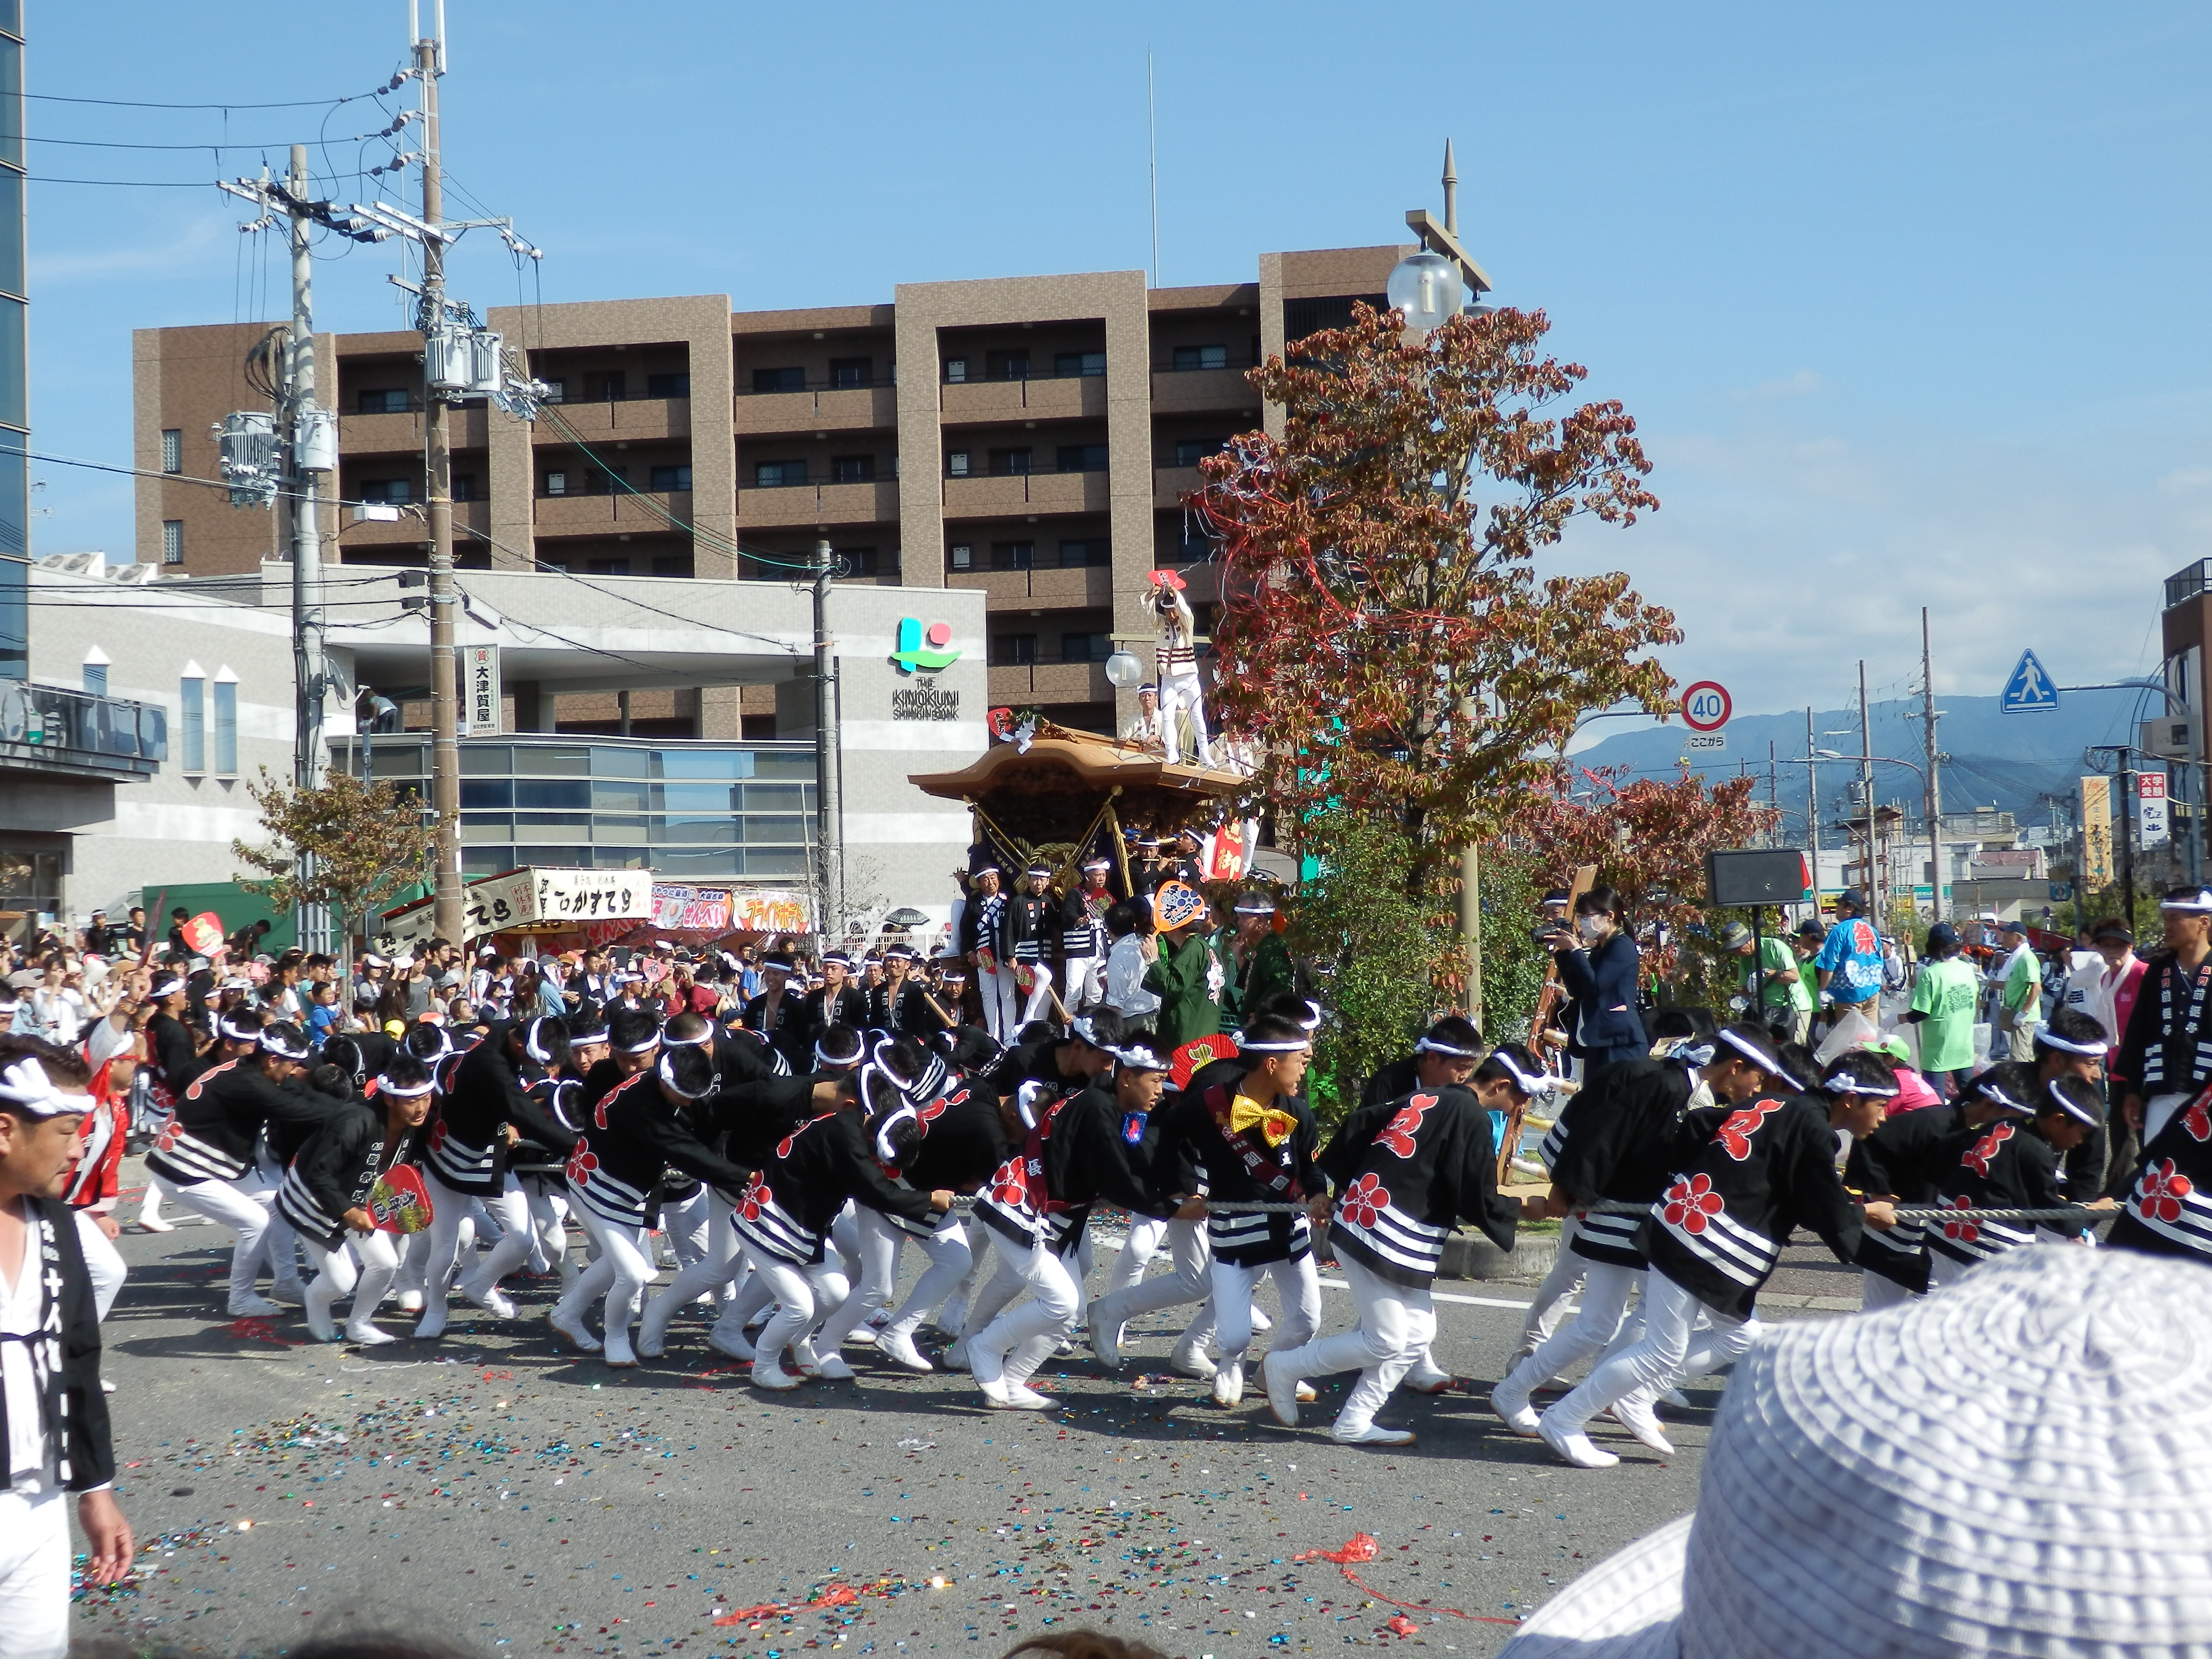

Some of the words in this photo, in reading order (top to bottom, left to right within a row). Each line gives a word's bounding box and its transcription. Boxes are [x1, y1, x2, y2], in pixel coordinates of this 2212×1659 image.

[477, 650, 486, 661] 質
[915, 676, 936, 690] THE
[476, 666, 490, 721] 大津賀屋
[893, 689, 959, 708] KINOKUNI
[893, 707, 931, 721] SHINKIN
[932, 708, 959, 721] BANK
[1693, 695, 1720, 717] 40
[1691, 737, 1724, 747] ここから
[2141, 776, 2163, 786] 大学
[2141, 787, 2163, 796] 受験
[683, 902, 726, 928] せんべい
[745, 899, 803, 929] フライドポテト
[1854, 921, 1876, 954] 祭
[1027, 1158, 1042, 1176] 長
